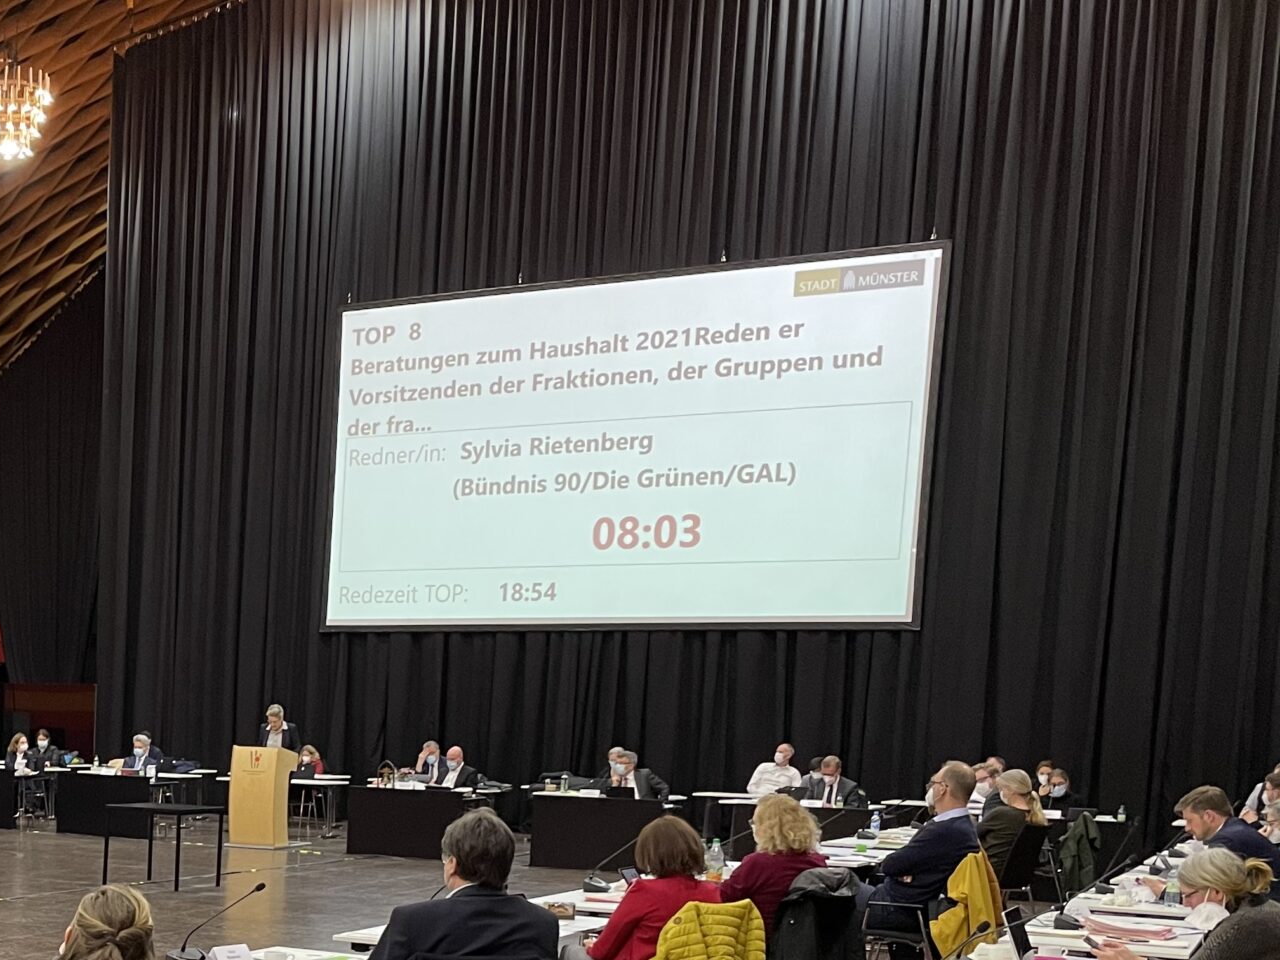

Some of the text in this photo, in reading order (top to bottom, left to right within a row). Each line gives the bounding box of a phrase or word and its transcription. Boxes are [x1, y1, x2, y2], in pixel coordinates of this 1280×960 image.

[798, 271, 919, 292] STADT MÜNSTER
[350, 351, 470, 376] Beratungen
[475, 347, 522, 365] zum
[529, 333, 630, 360] Haushalt
[778, 321, 805, 339] er
[352, 322, 422, 346] TOP 8
[349, 345, 884, 406] Vorsitzenden der Fraktionen, der Gruppen und
[347, 415, 432, 437] der fra...
[348, 431, 654, 467] Redner/in: Sylvia Rietenberg
[453, 461, 797, 501] (Bündnis 90/Die Grünen/GAL)
[591, 512, 702, 551] 08:03
[339, 581, 557, 605] Redezeit TOP: 18:54
